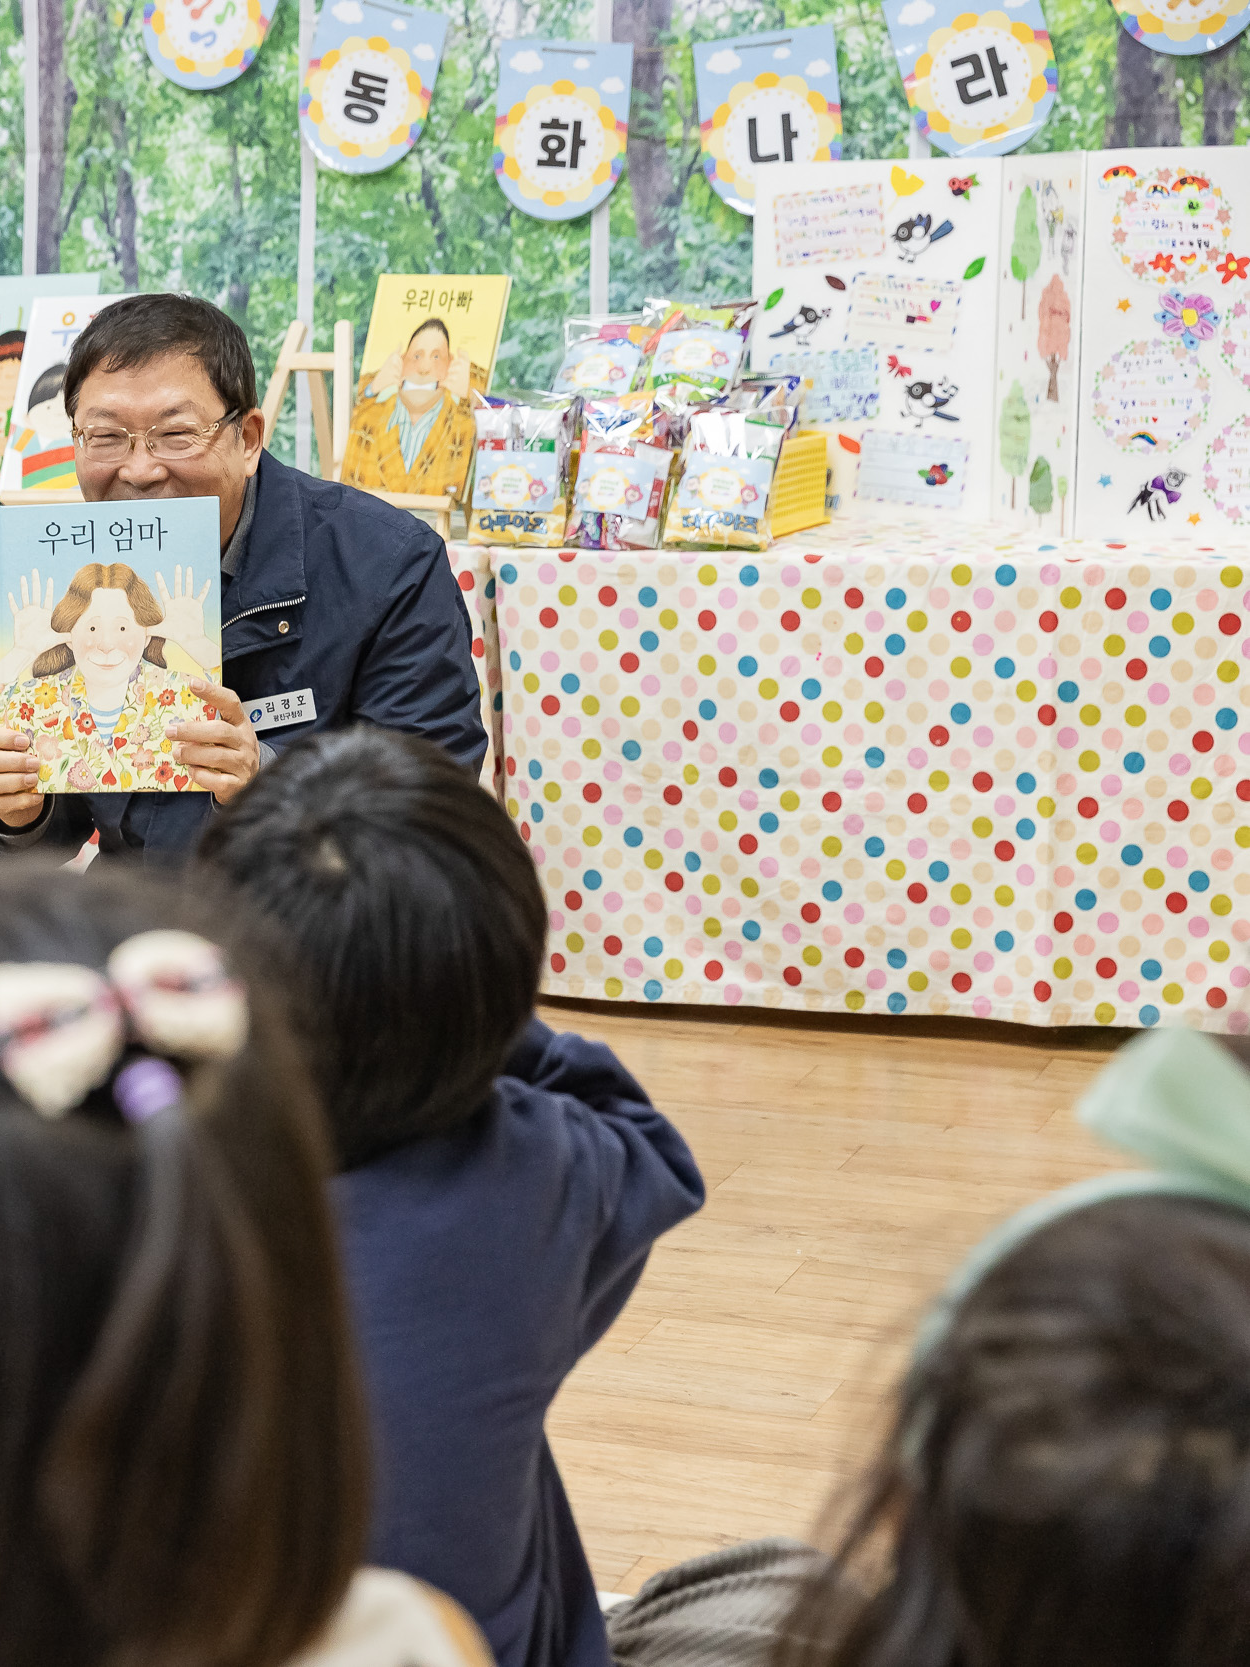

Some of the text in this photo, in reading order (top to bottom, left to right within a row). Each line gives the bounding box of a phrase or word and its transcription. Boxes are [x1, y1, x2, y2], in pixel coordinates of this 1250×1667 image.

[343, 46, 1009, 169] 동 화 나 라
[402, 288, 474, 313] 우리 아빠
[51, 311, 97, 348] 우
[38, 516, 169, 556] 우리 엄마
[682, 510, 759, 534] 다아즈
